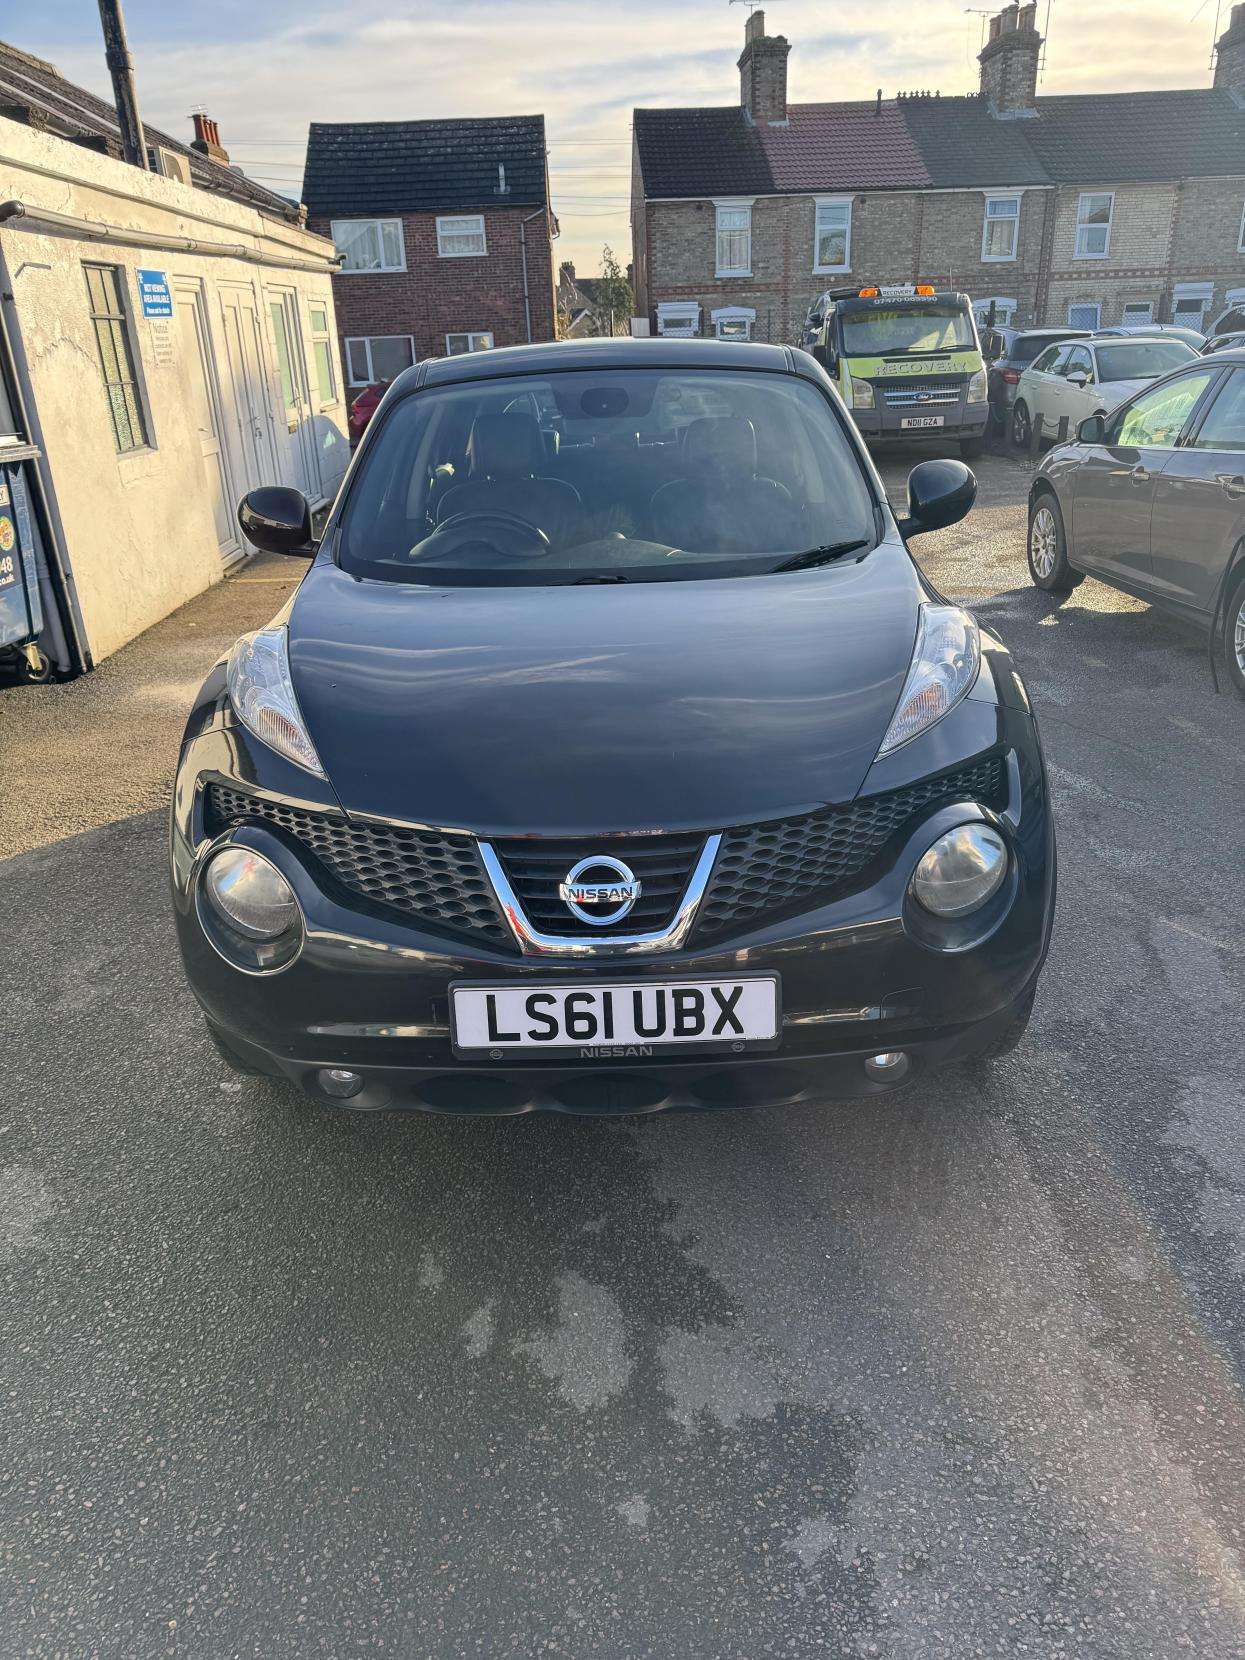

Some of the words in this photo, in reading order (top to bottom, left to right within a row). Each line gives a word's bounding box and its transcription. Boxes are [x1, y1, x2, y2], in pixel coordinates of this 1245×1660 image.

[875, 361, 967, 376] RECOVERY
[923, 417, 938, 426] GZA
[568, 886, 633, 899] NISSAN
[486, 992, 614, 1042] LS61
[632, 986, 744, 1038] UBX
[580, 1046, 653, 1058] NISSAN
